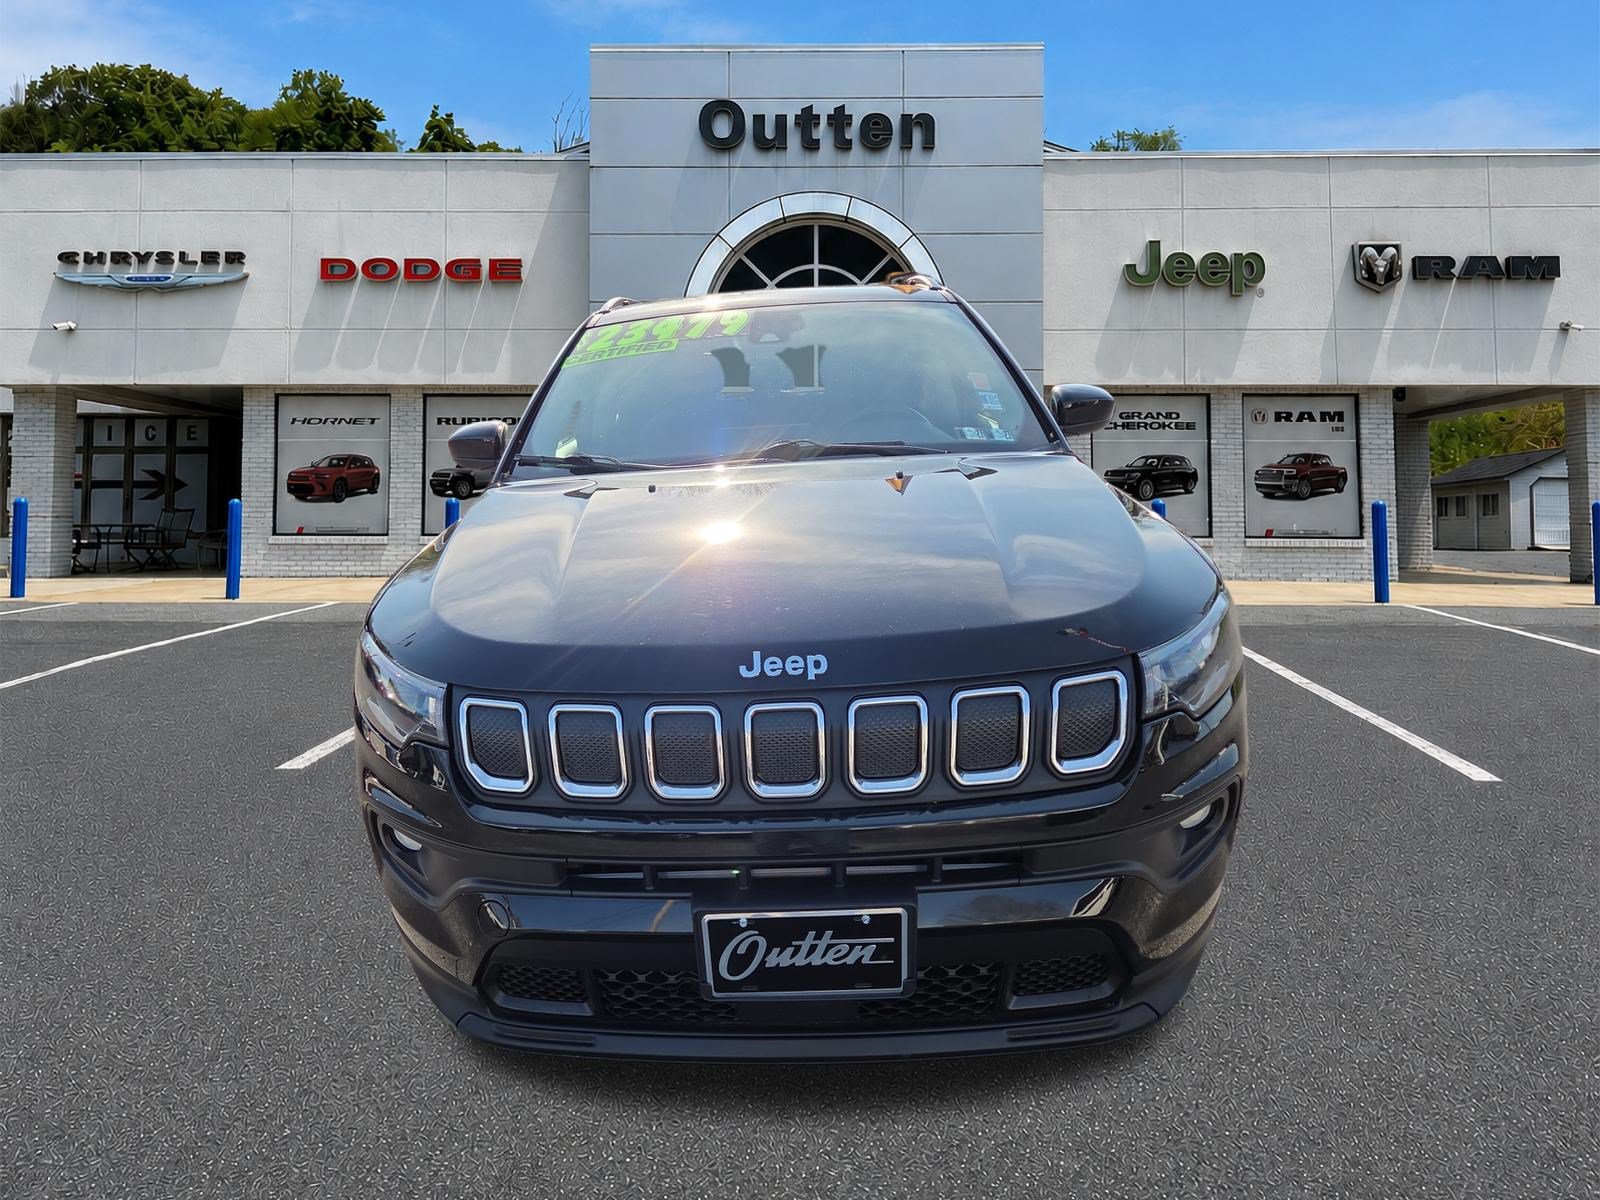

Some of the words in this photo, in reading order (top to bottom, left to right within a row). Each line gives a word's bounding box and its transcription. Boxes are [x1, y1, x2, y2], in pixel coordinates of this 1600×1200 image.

[699, 99, 935, 150] Outten
[57, 250, 247, 266] CHRYSLER
[320, 257, 523, 282] DODGE
[1123, 240, 1266, 297] Jeep
[1411, 255, 1561, 280] RAM
[565, 340, 674, 366] CERTIFIED
[290, 416, 381, 426] HORNET
[1118, 411, 1181, 420] GRAND
[1274, 410, 1345, 423] RAM
[739, 650, 829, 680] Jeep
[718, 930, 895, 981] Outten
